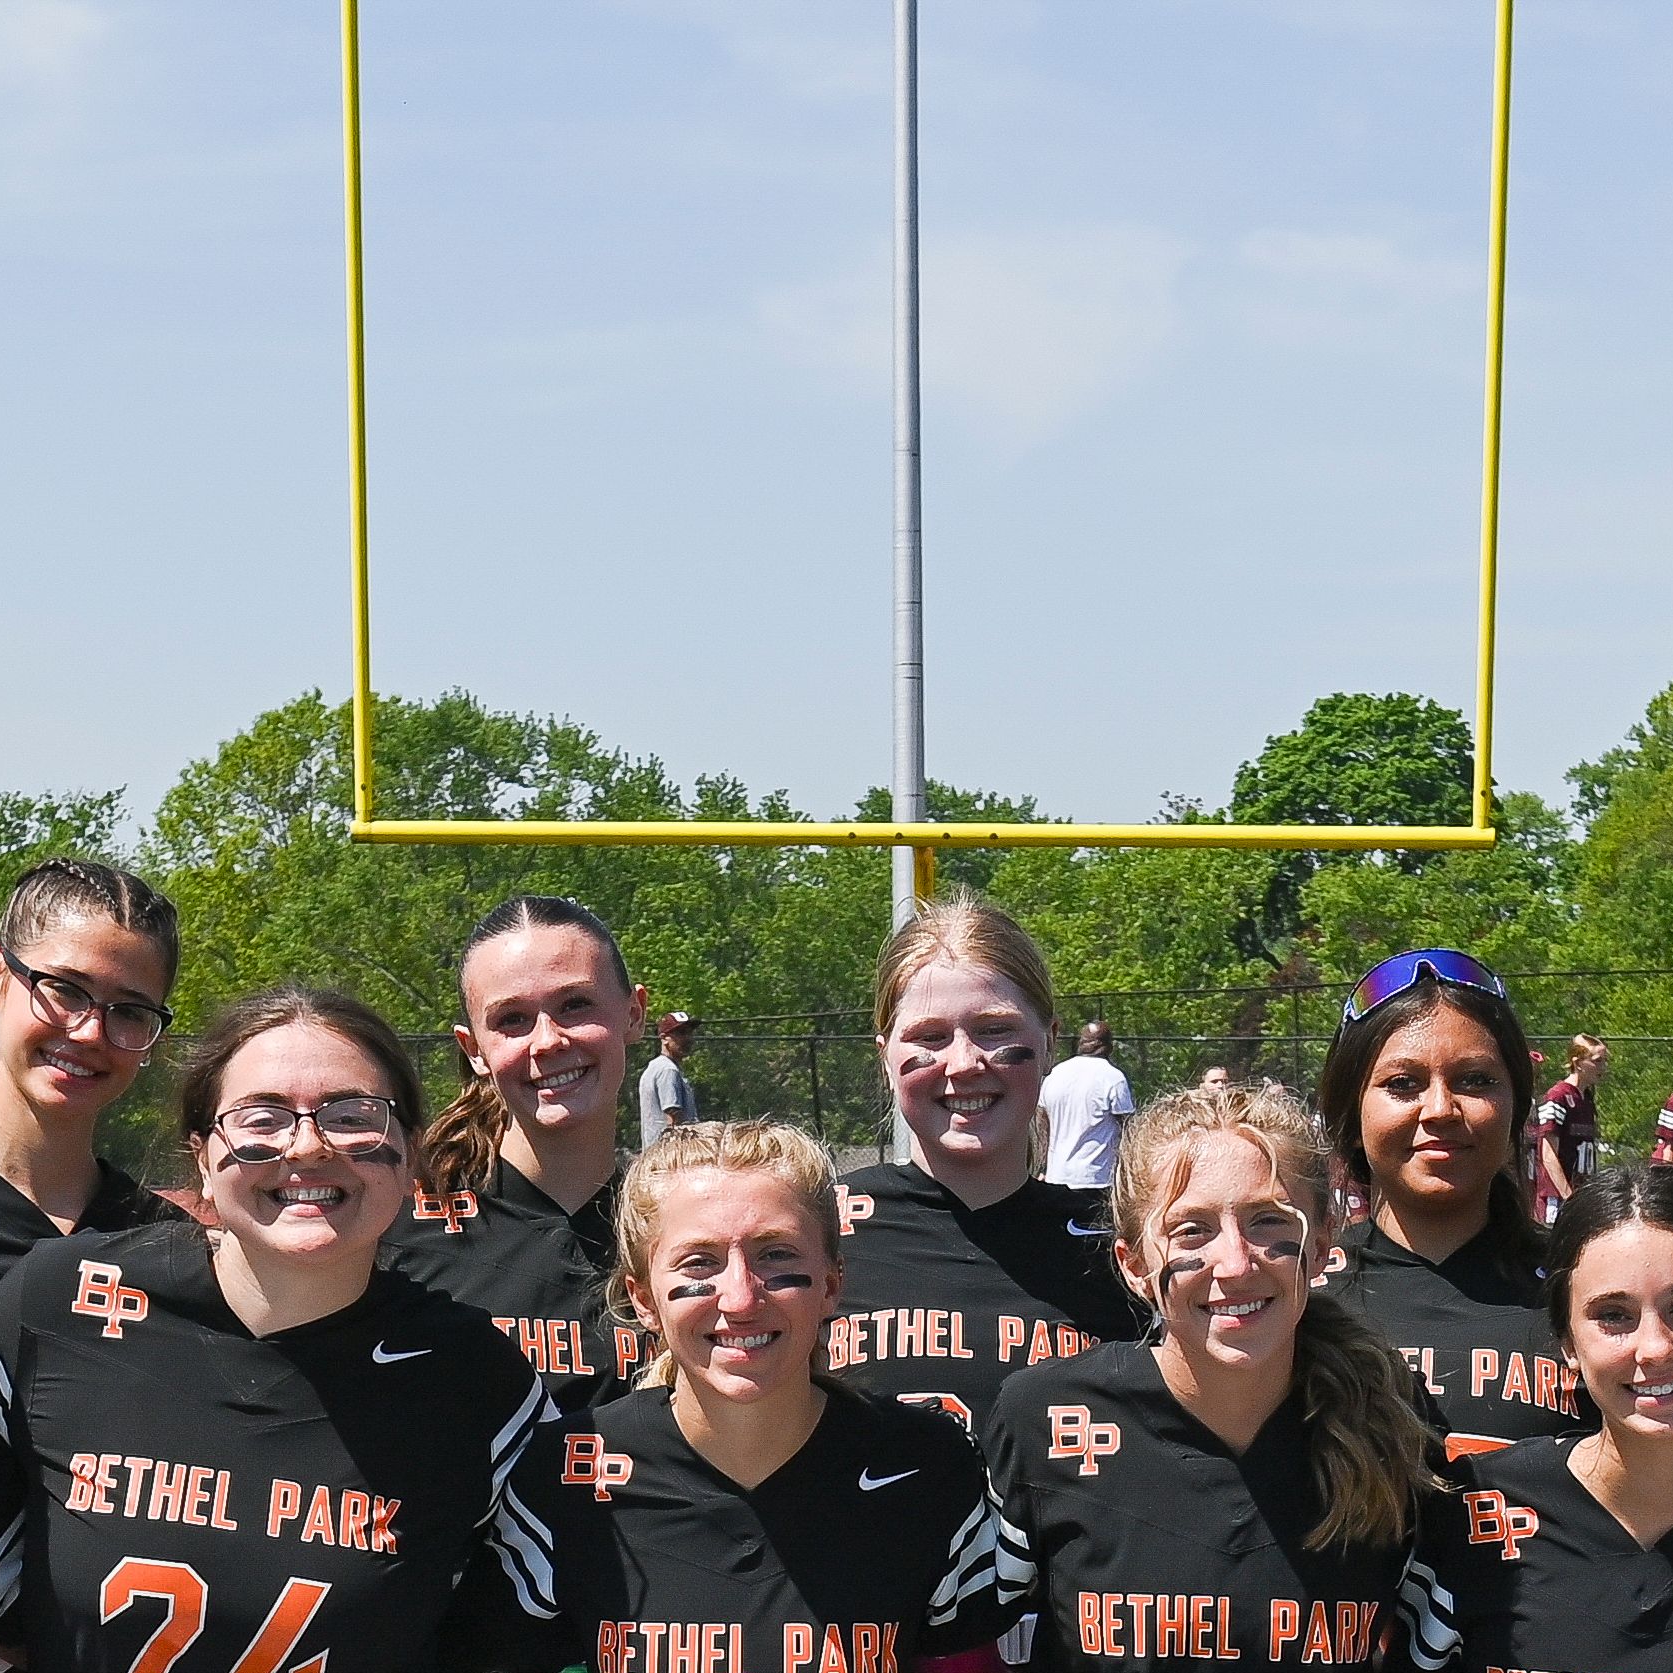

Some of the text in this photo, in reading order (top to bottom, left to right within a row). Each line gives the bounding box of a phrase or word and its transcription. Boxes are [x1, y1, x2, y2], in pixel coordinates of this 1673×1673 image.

[71, 1259, 149, 1339] BP
[828, 1308, 974, 1371] BETHEL
[1471, 1348, 1581, 1419] PARK
[561, 1433, 633, 1501] BP
[1046, 1404, 1121, 1476] BP
[64, 1452, 402, 1555] BETHEL PARK
[1462, 1489, 1540, 1560] BP
[1078, 1591, 1380, 1665] BETHEL PARK
